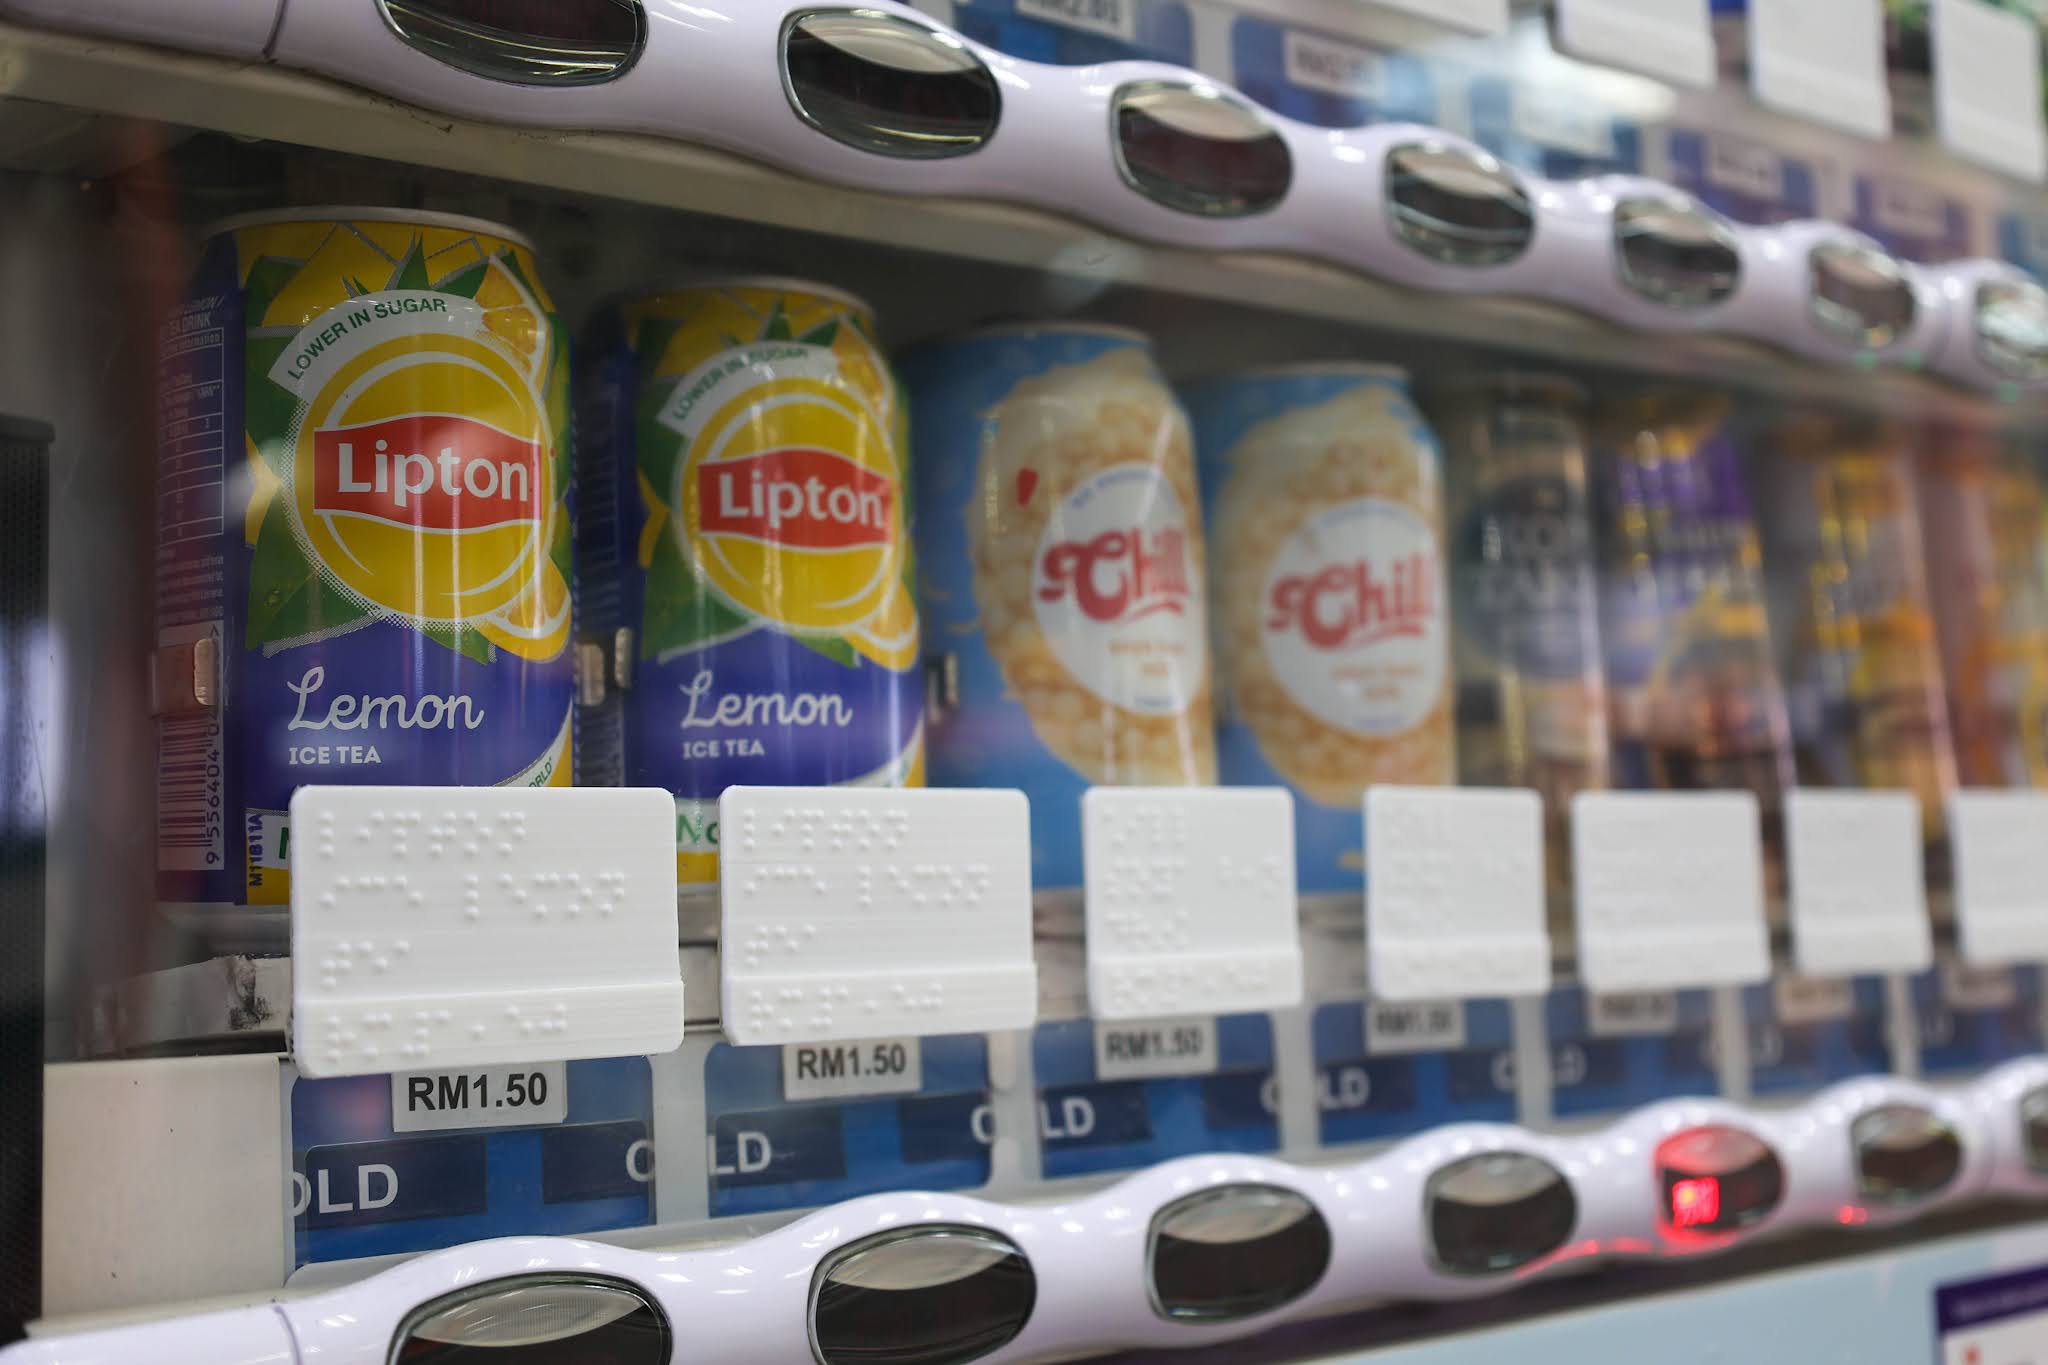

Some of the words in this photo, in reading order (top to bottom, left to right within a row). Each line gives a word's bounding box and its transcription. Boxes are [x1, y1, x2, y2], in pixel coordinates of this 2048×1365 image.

[288, 322, 348, 380] LOWER
[348, 309, 371, 328] IN
[374, 298, 447, 319] SUGAR
[672, 368, 726, 420] LOWER
[338, 439, 529, 507] Lipton
[719, 469, 884, 528] Lipton
[1040, 530, 1187, 623] Chill
[1267, 553, 1433, 648] Chill
[287, 666, 485, 731] Lemon
[680, 669, 853, 728] Lemon
[288, 745, 330, 765] ICE
[336, 745, 382, 764] TEA
[683, 740, 720, 760] ICE
[725, 739, 765, 756] TEA
[796, 1045, 907, 1079] RM1.50
[1105, 1027, 1202, 1059] RM1.50
[408, 1072, 547, 1112] RM1.50
